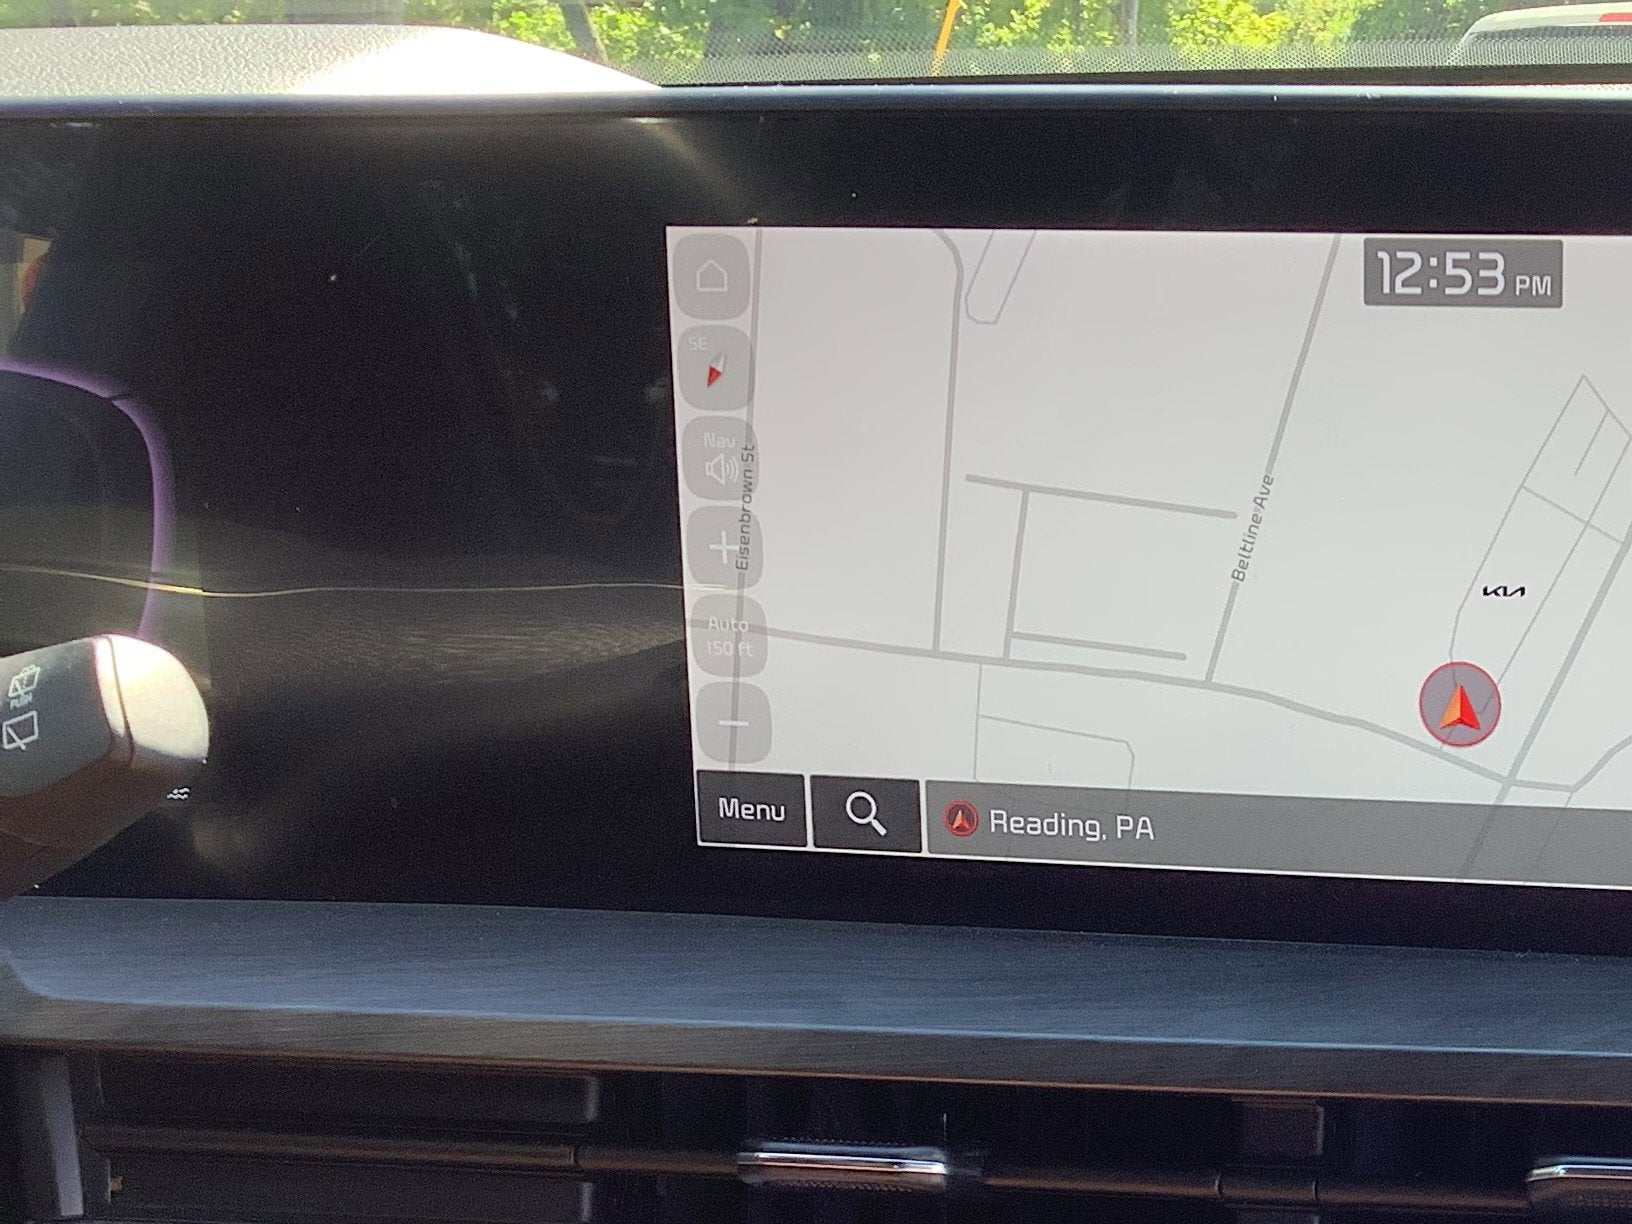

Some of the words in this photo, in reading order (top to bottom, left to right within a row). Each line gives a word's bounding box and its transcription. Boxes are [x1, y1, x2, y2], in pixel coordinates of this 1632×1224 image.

[1377, 250, 1506, 296] 12:53
[1515, 275, 1552, 297] PM
[703, 431, 736, 449] Nav
[740, 443, 755, 463] St
[735, 468, 753, 571] Eisenbrown
[1230, 512, 1263, 582] Beltline
[1252, 474, 1274, 510] Ave
[708, 615, 750, 633] Auto
[706, 640, 733, 656] 150
[718, 796, 786, 822] Menu
[990, 809, 1107, 842] Reading,
[1116, 815, 1155, 840] PA
